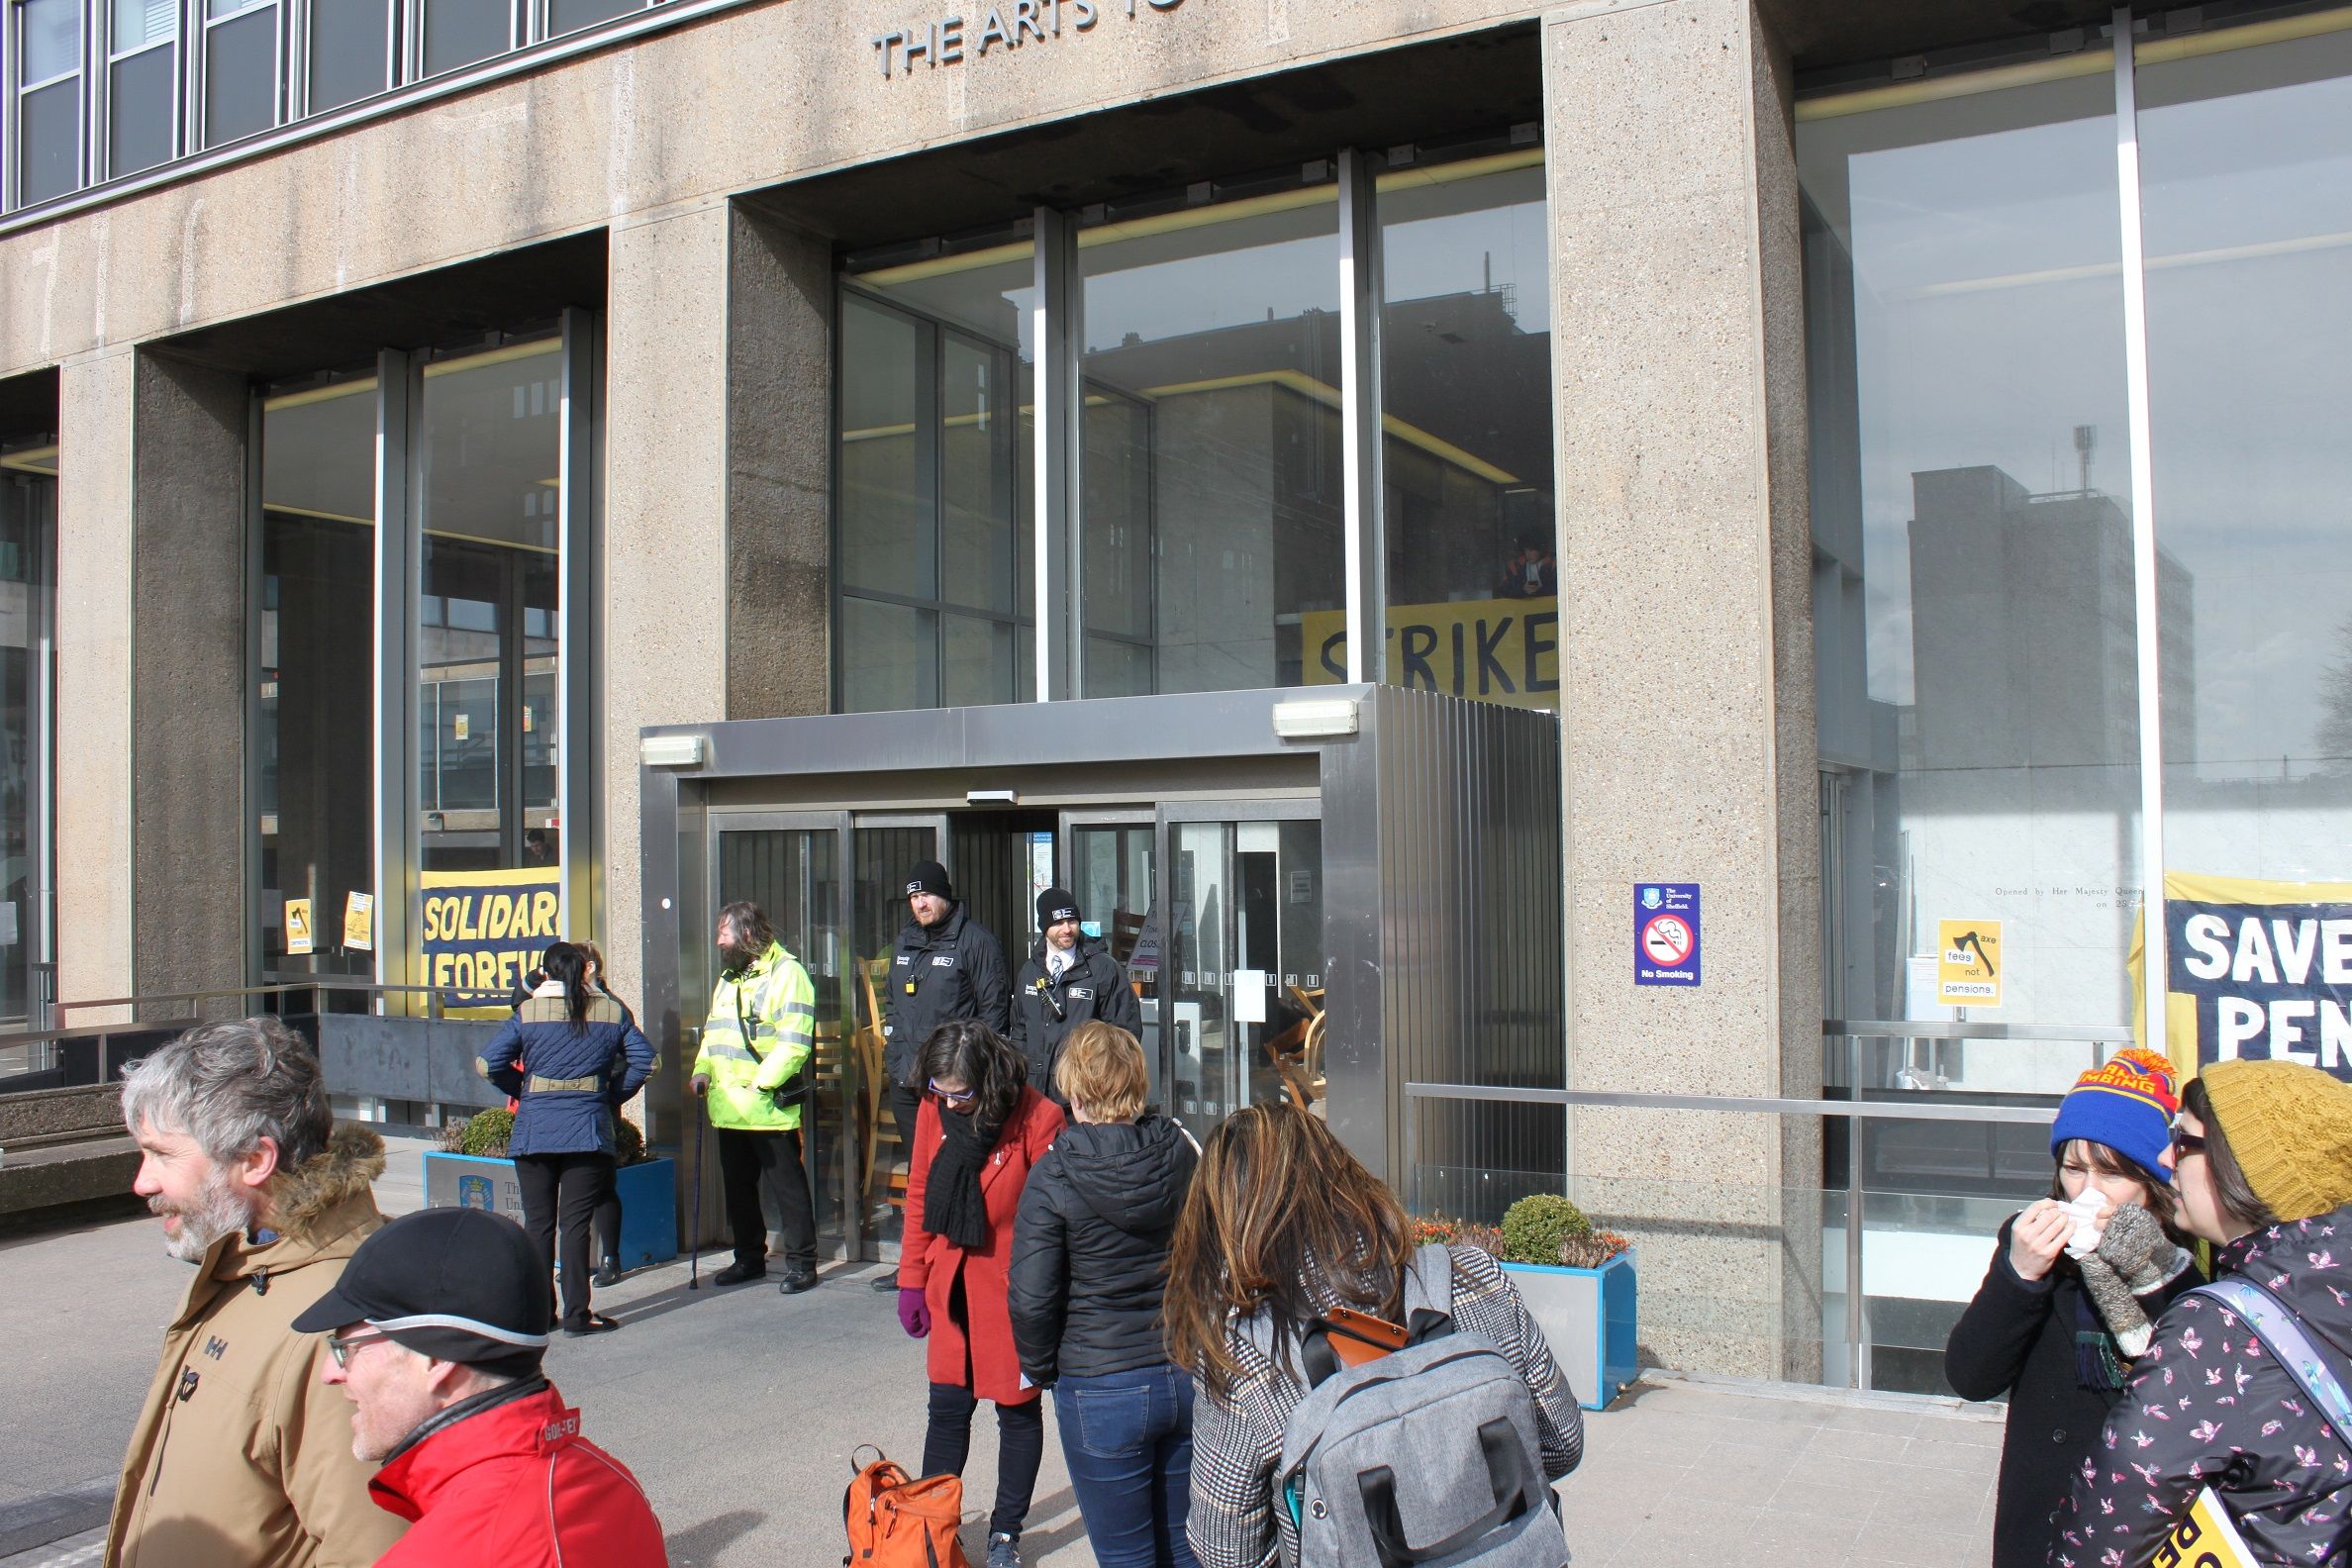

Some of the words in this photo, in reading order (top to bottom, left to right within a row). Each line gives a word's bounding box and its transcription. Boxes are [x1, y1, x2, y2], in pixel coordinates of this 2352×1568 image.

[870, 15, 964, 79] THE
[977, 0, 1099, 55] ARTS
[1320, 612, 1561, 698] SRIKE
[1995, 887, 2028, 897] Opened
[2035, 887, 2044, 897] by
[2075, 887, 2108, 897] Majesty
[1139, 939, 1158, 948] CLOS
[1980, 935, 1997, 944] axe
[2184, 913, 2352, 985] SAVE
[1947, 952, 1972, 962] fees
[435, 950, 545, 1000] FOREV
[1656, 970, 1694, 981] Smoking
[1945, 985, 1994, 994] pensions.
[2217, 996, 2352, 1068] PEN
[504, 1181, 521, 1195] Th
